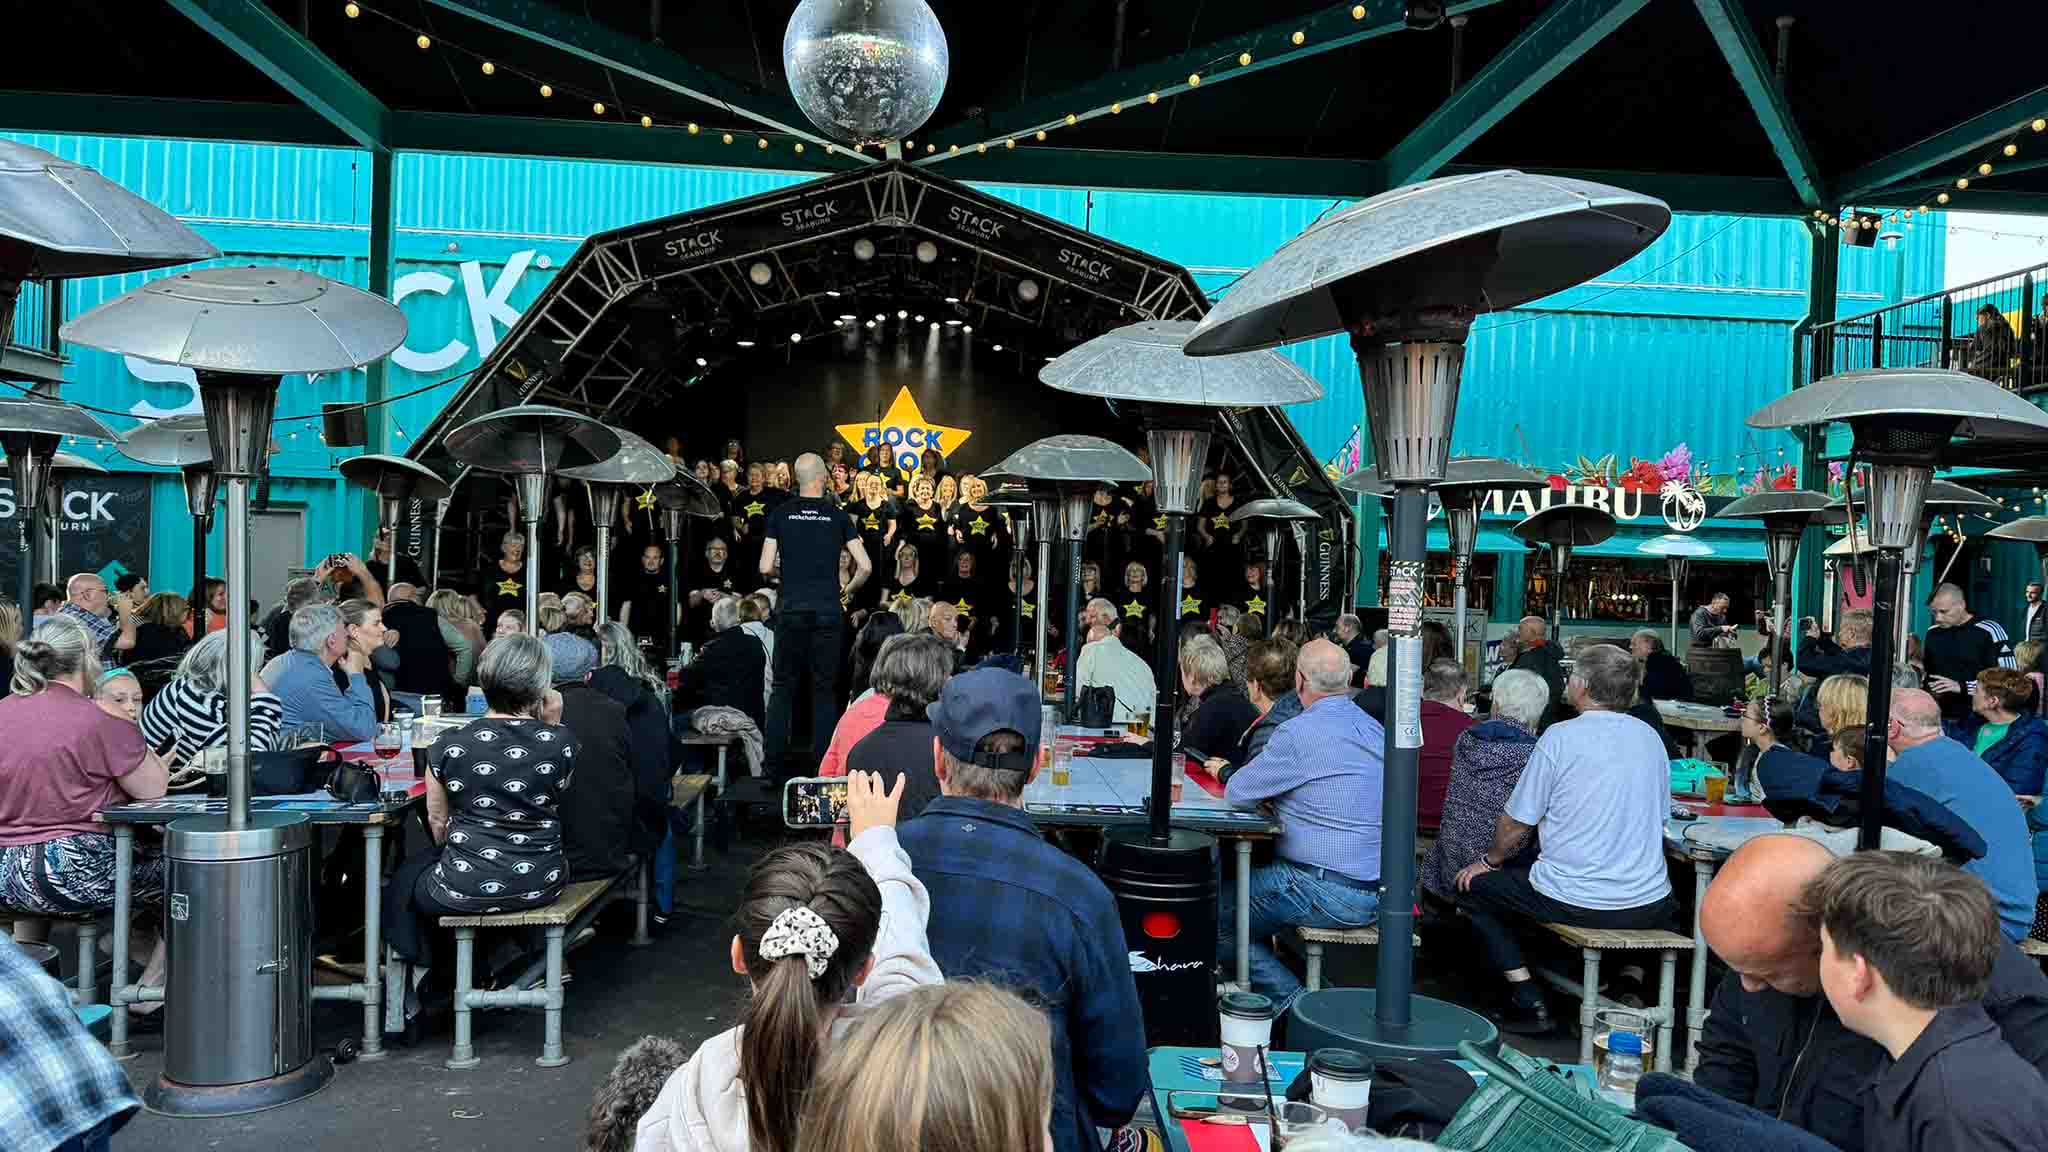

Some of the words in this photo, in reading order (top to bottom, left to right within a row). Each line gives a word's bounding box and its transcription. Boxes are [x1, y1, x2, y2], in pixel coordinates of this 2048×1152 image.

[782, 199, 839, 227] STACK
[948, 206, 1005, 239] STACK
[664, 229, 723, 257] STACK
[1057, 248, 1113, 280] STACK
[863, 426, 944, 449] ROCK
[1319, 542, 1331, 601] GUINNESS
